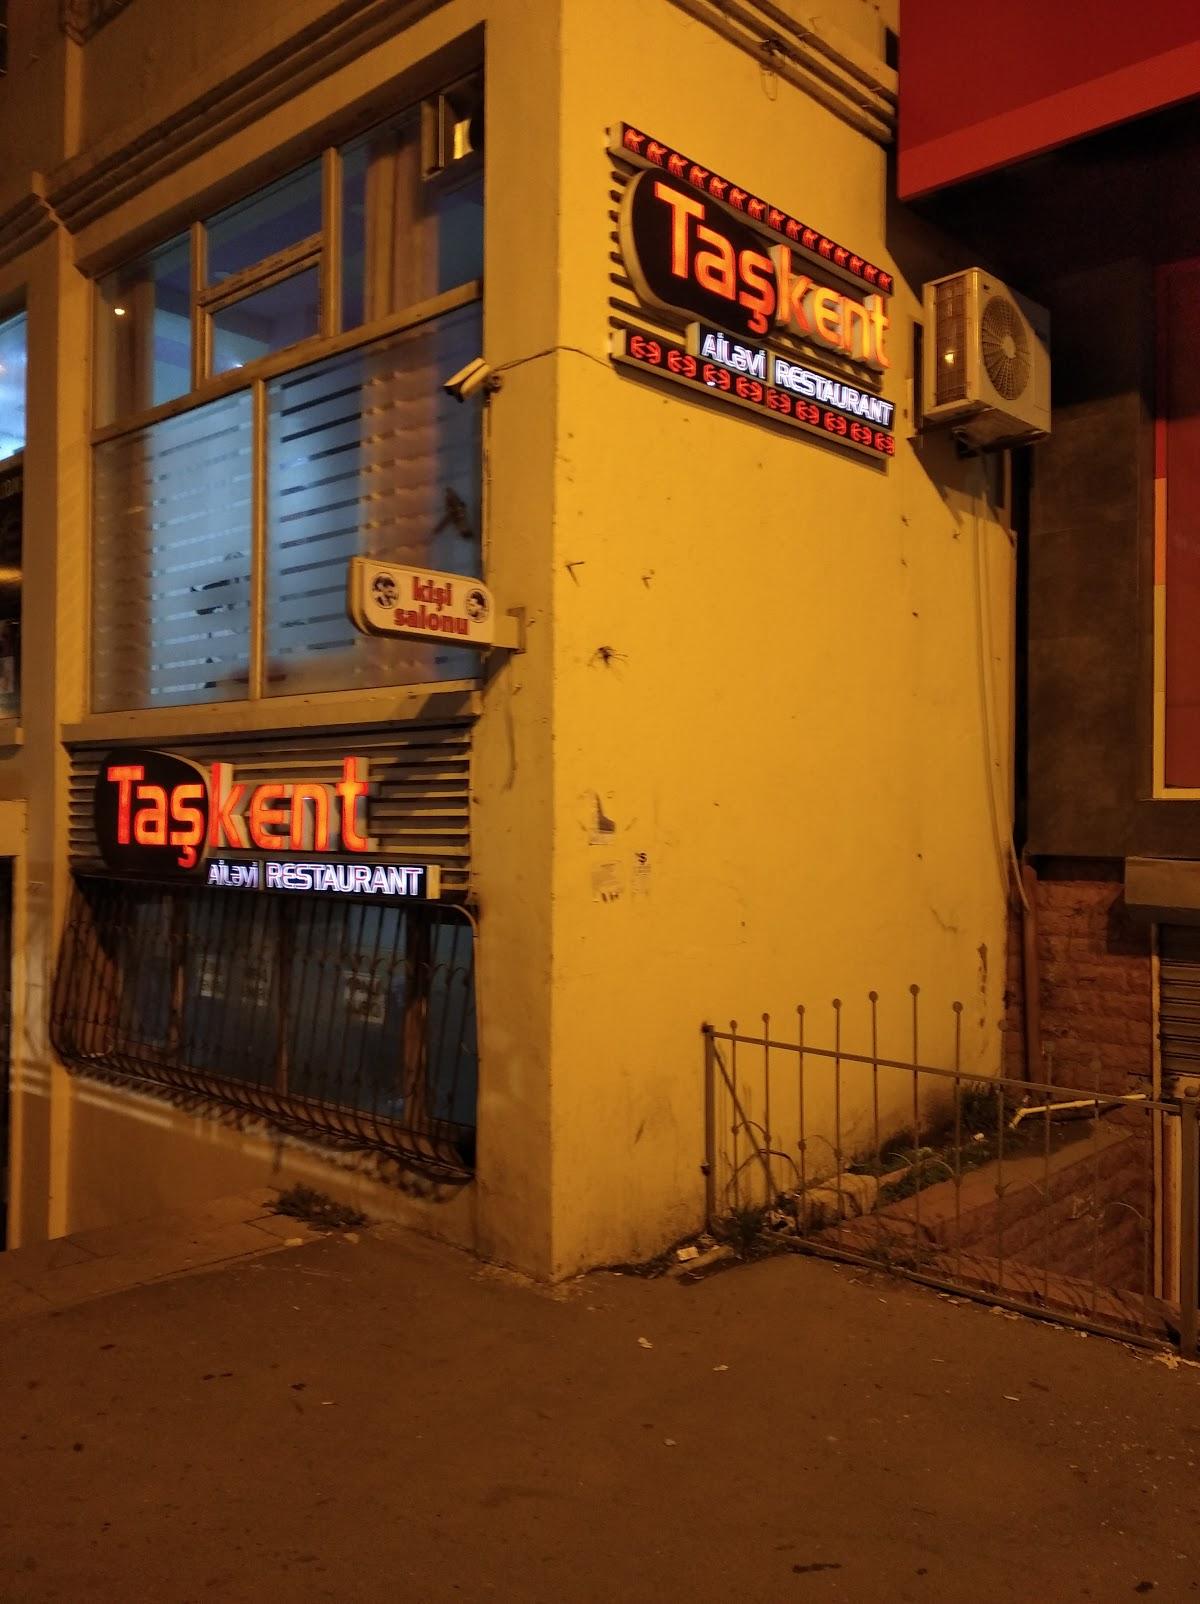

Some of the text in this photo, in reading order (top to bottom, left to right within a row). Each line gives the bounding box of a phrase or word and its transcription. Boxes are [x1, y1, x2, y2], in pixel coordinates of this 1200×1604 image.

[653, 181, 890, 367] Taşkent
[775, 359, 894, 426] RESTAURANT
[412, 575, 453, 611] kişi
[394, 605, 469, 635] salonu
[107, 757, 370, 868] Taşkent
[267, 864, 424, 896] RESTAURANT
